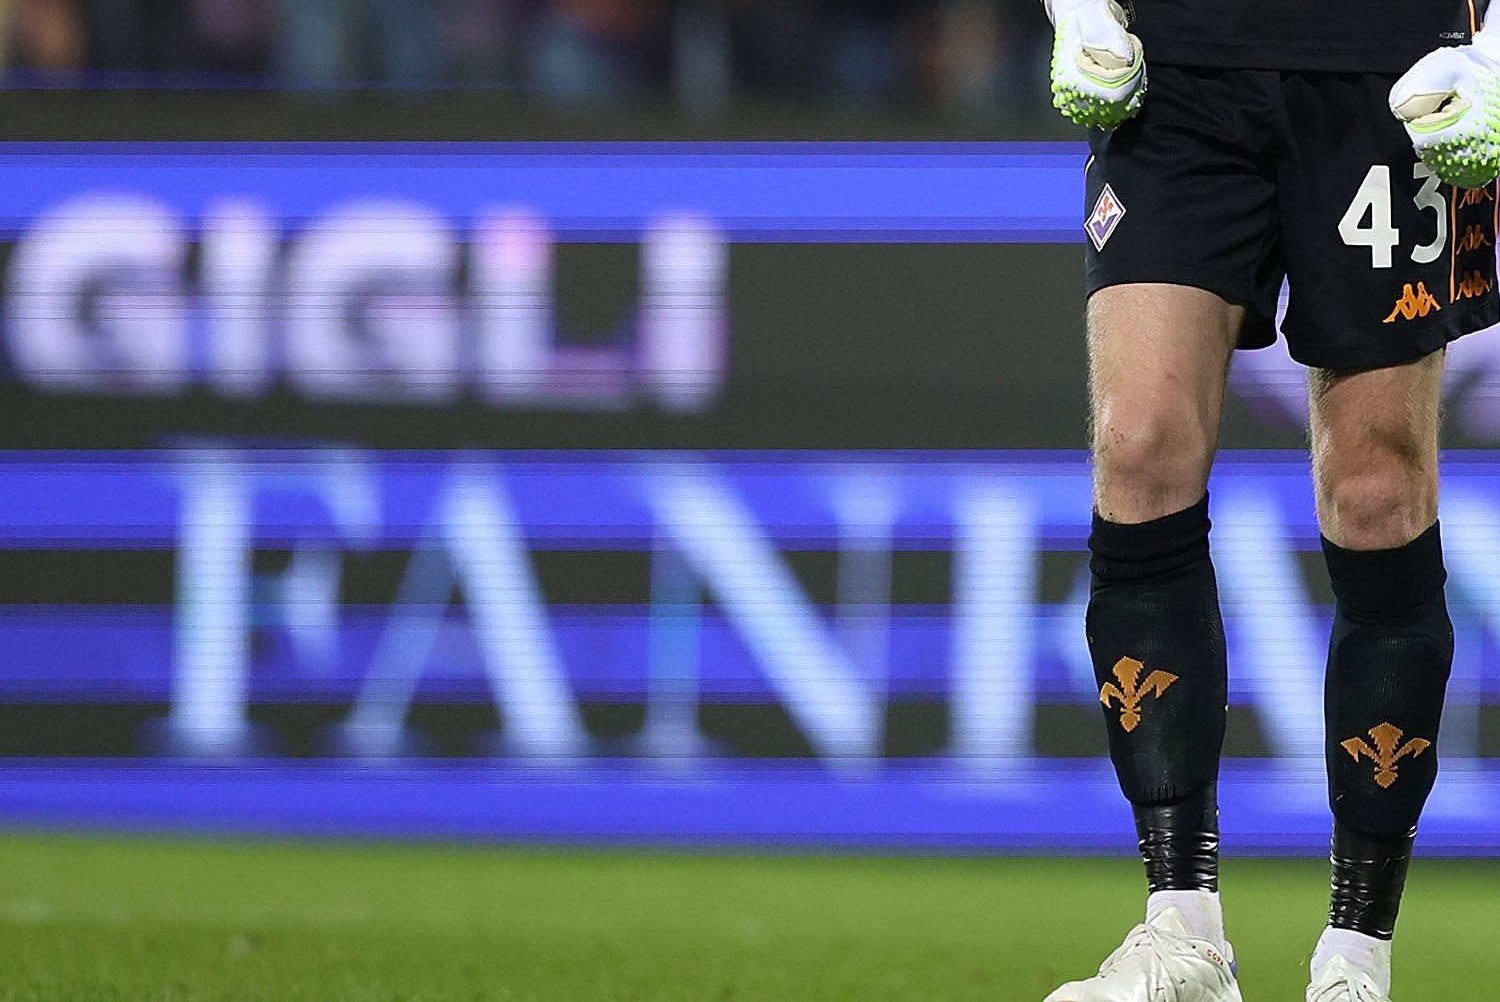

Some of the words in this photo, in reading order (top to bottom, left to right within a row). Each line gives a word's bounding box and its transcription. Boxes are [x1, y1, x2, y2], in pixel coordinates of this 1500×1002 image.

[1439, 31, 1466, 40] KOMBAT
[1337, 161, 1448, 269] 43
[4, 190, 732, 414] GIGLI
